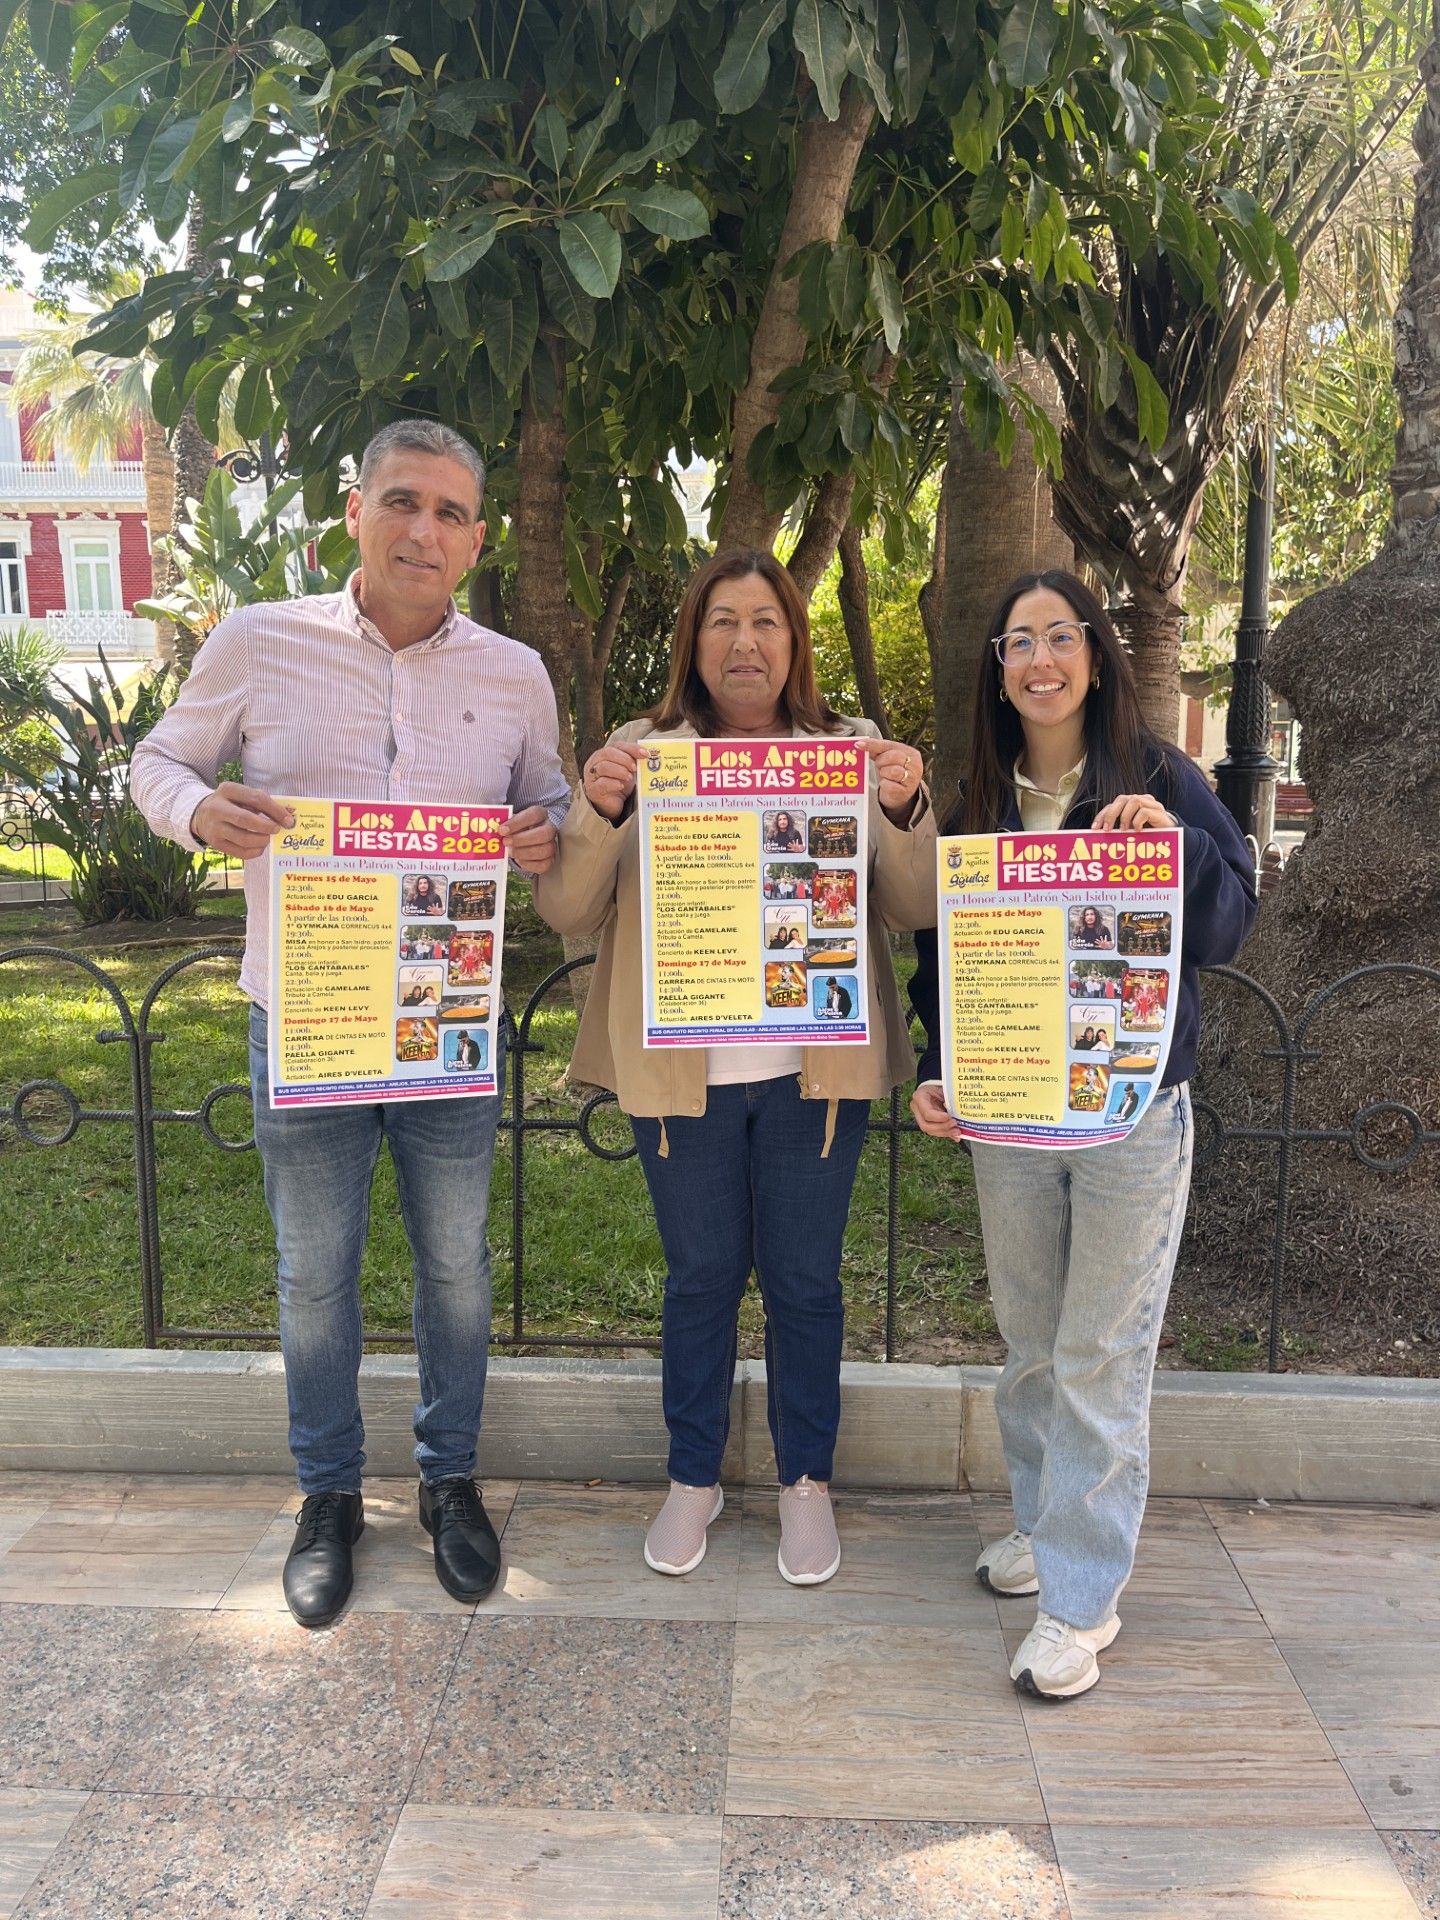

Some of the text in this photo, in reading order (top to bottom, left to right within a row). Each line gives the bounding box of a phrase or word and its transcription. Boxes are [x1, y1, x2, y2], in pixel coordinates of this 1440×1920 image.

[700, 745, 857, 770] Los Arejos
[701, 769, 859, 788] FIESTAS 2026
[662, 798, 694, 808] Honor
[721, 797, 753, 807] Patrón
[756, 797, 775, 807] San
[779, 797, 808, 806] Isidro
[811, 797, 857, 806] Labrador
[339, 807, 501, 836] Los Arejos
[715, 815, 739, 823] Mayo
[339, 830, 500, 853] FIESTAS 2026
[655, 844, 687, 852] Sábado
[1002, 837, 1171, 863] Los Arejos
[296, 857, 329, 868] Honor
[360, 859, 393, 869] Patrón
[397, 862, 416, 870] San
[420, 861, 450, 871] Isidro
[453, 861, 496, 871] Labrador
[663, 854, 682, 864] partir
[1003, 862, 1172, 883] FIESTAS 2026
[285, 874, 323, 882] Viernes
[352, 876, 377, 884] Mayo
[963, 894, 995, 904] Honor
[1025, 891, 1057, 902] Patrón
[1062, 891, 1081, 901] San
[1086, 891, 1117, 901] Isidro
[1121, 891, 1171, 901] Labrador
[285, 904, 320, 912] Sábado
[350, 905, 374, 913] Mayo
[294, 915, 316, 924] partir
[317, 914, 327, 922] de
[329, 914, 339, 922] las
[1018, 910, 1042, 918] Mayo
[1016, 940, 1040, 948] Mayo
[962, 951, 983, 960] partir
[354, 1015, 378, 1024] Mayo
[957, 1057, 998, 1065] Domingo
[1026, 1058, 1050, 1066] Mayo
